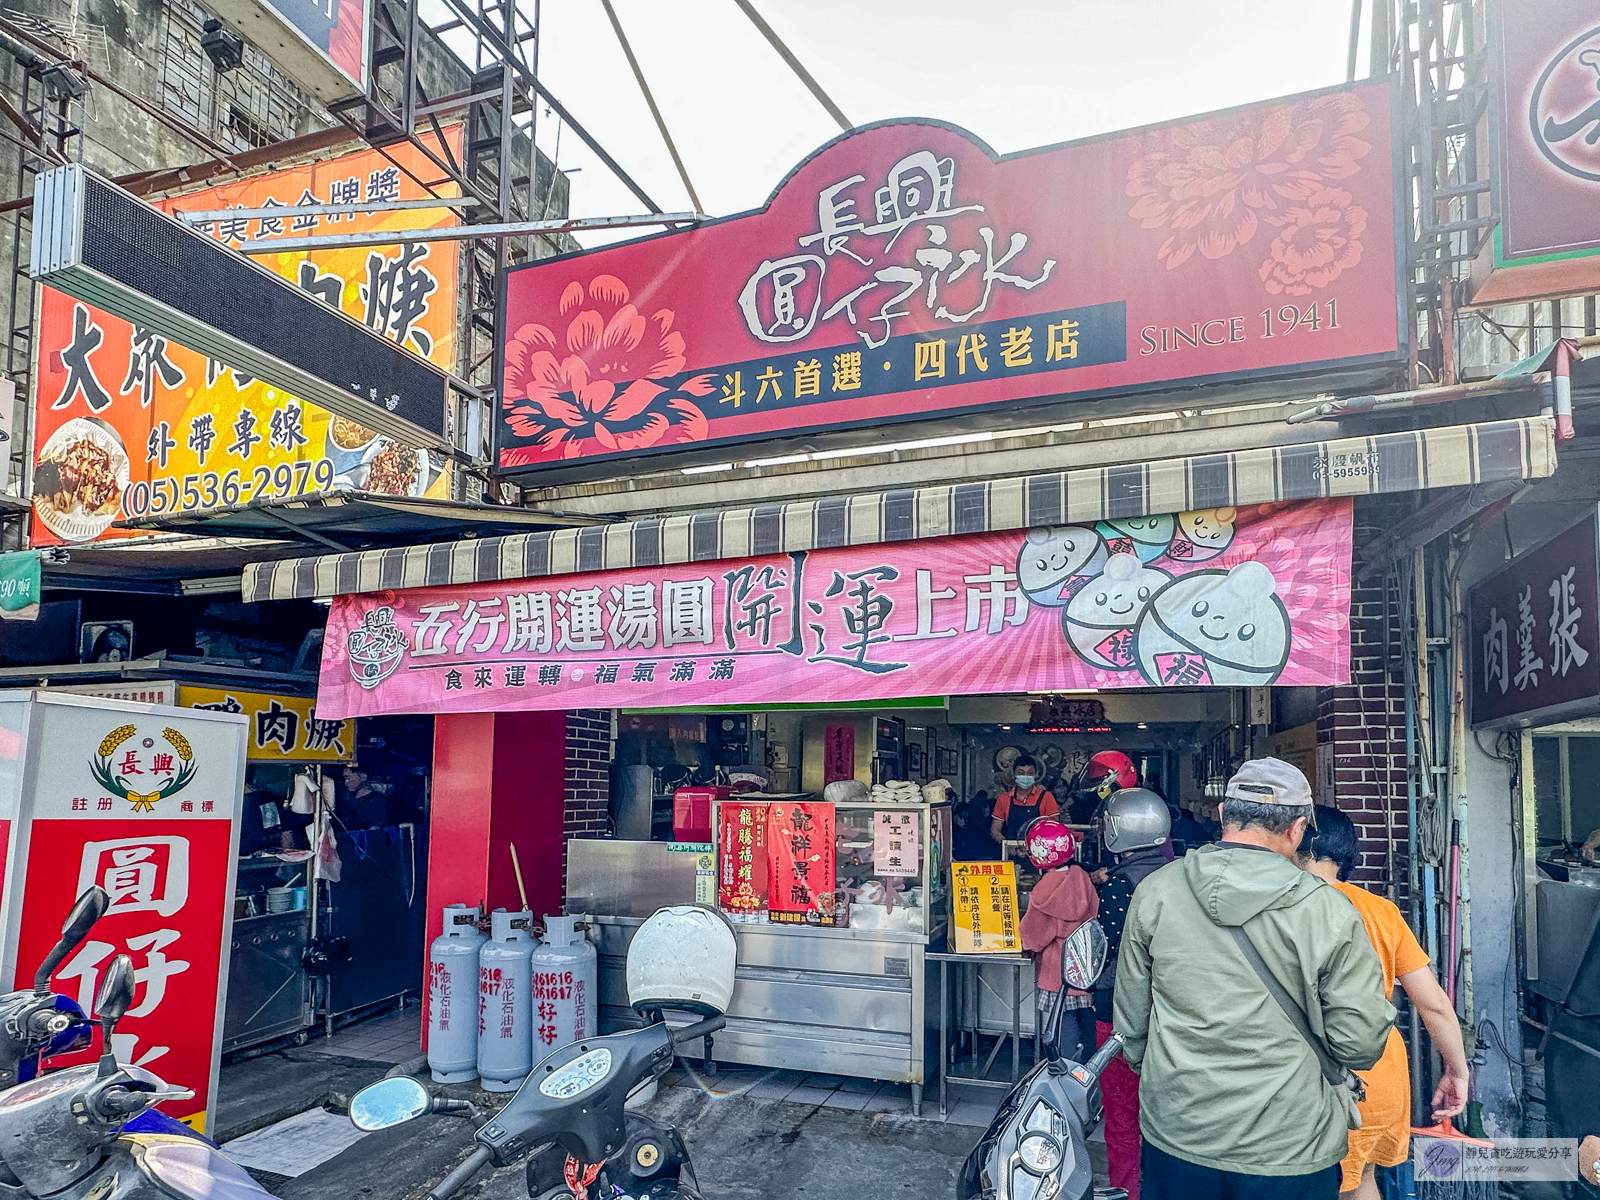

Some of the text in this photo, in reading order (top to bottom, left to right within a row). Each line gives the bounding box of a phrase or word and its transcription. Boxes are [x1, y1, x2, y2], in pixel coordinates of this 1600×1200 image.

[1140, 299, 1341, 356] SINCE 1941
[147, 405, 307, 469] 外帶專線
[122, 458, 336, 518] (05)536-2979
[118, 750, 175, 776] 長興
[180, 800, 214, 813] 商標
[500, 978, 514, 1039] 液化石油氣
